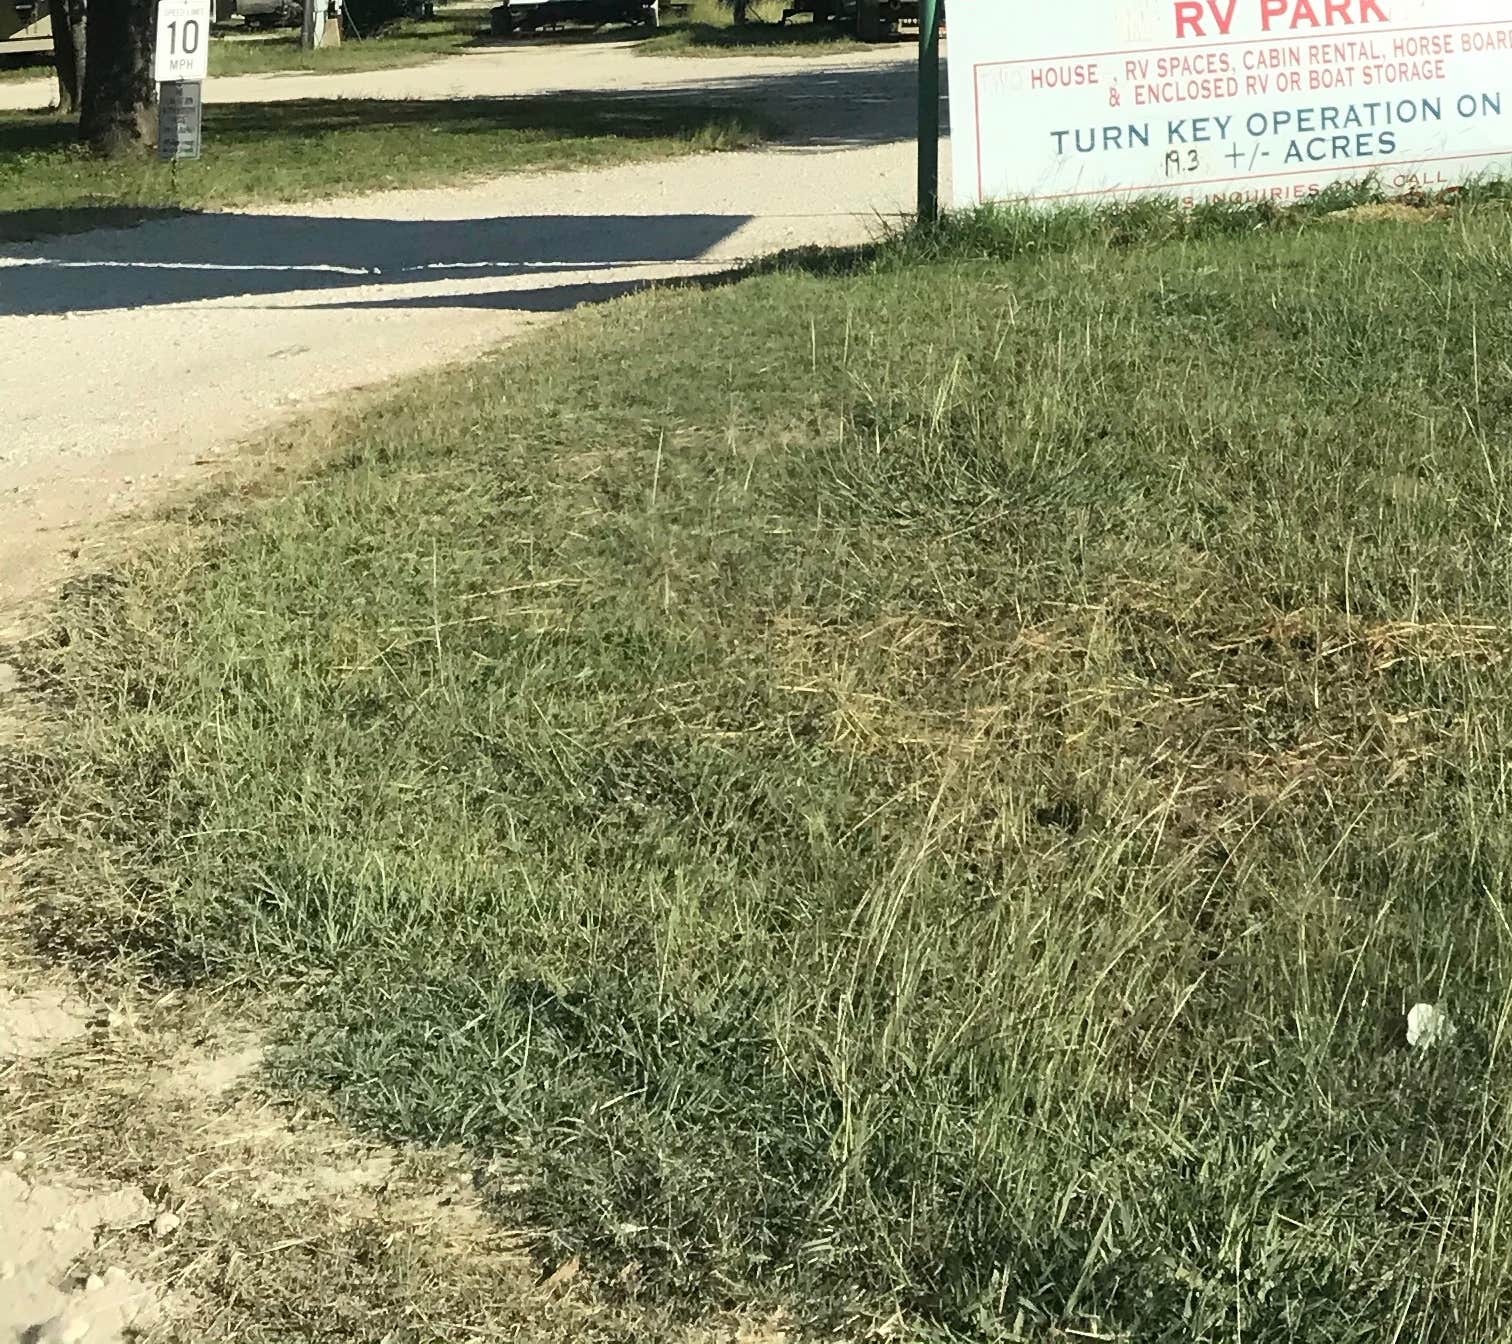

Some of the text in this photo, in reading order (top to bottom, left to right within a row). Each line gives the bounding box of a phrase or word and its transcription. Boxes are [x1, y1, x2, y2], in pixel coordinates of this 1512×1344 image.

[167, 20, 199, 55] 10
[169, 59, 193, 72] MPH
[1031, 64, 1098, 89] HOUSE
[1125, 59, 1150, 81] RV
[1157, 52, 1236, 77] SPACES,
[1242, 46, 1301, 71] CABIN
[1309, 42, 1386, 66] RENTAL,
[1392, 34, 1453, 58] HORSE
[1108, 59, 1446, 107] & ENCLOSED RV OR BOAT STORAGE
[1050, 92, 1502, 155] TURN KEY OPERATION ON
[1284, 131, 1397, 163] ACRES
[1205, 183, 1320, 204] INQUIRIES
[1331, 175, 1383, 191] ONY
[1393, 171, 1448, 188] CALL
